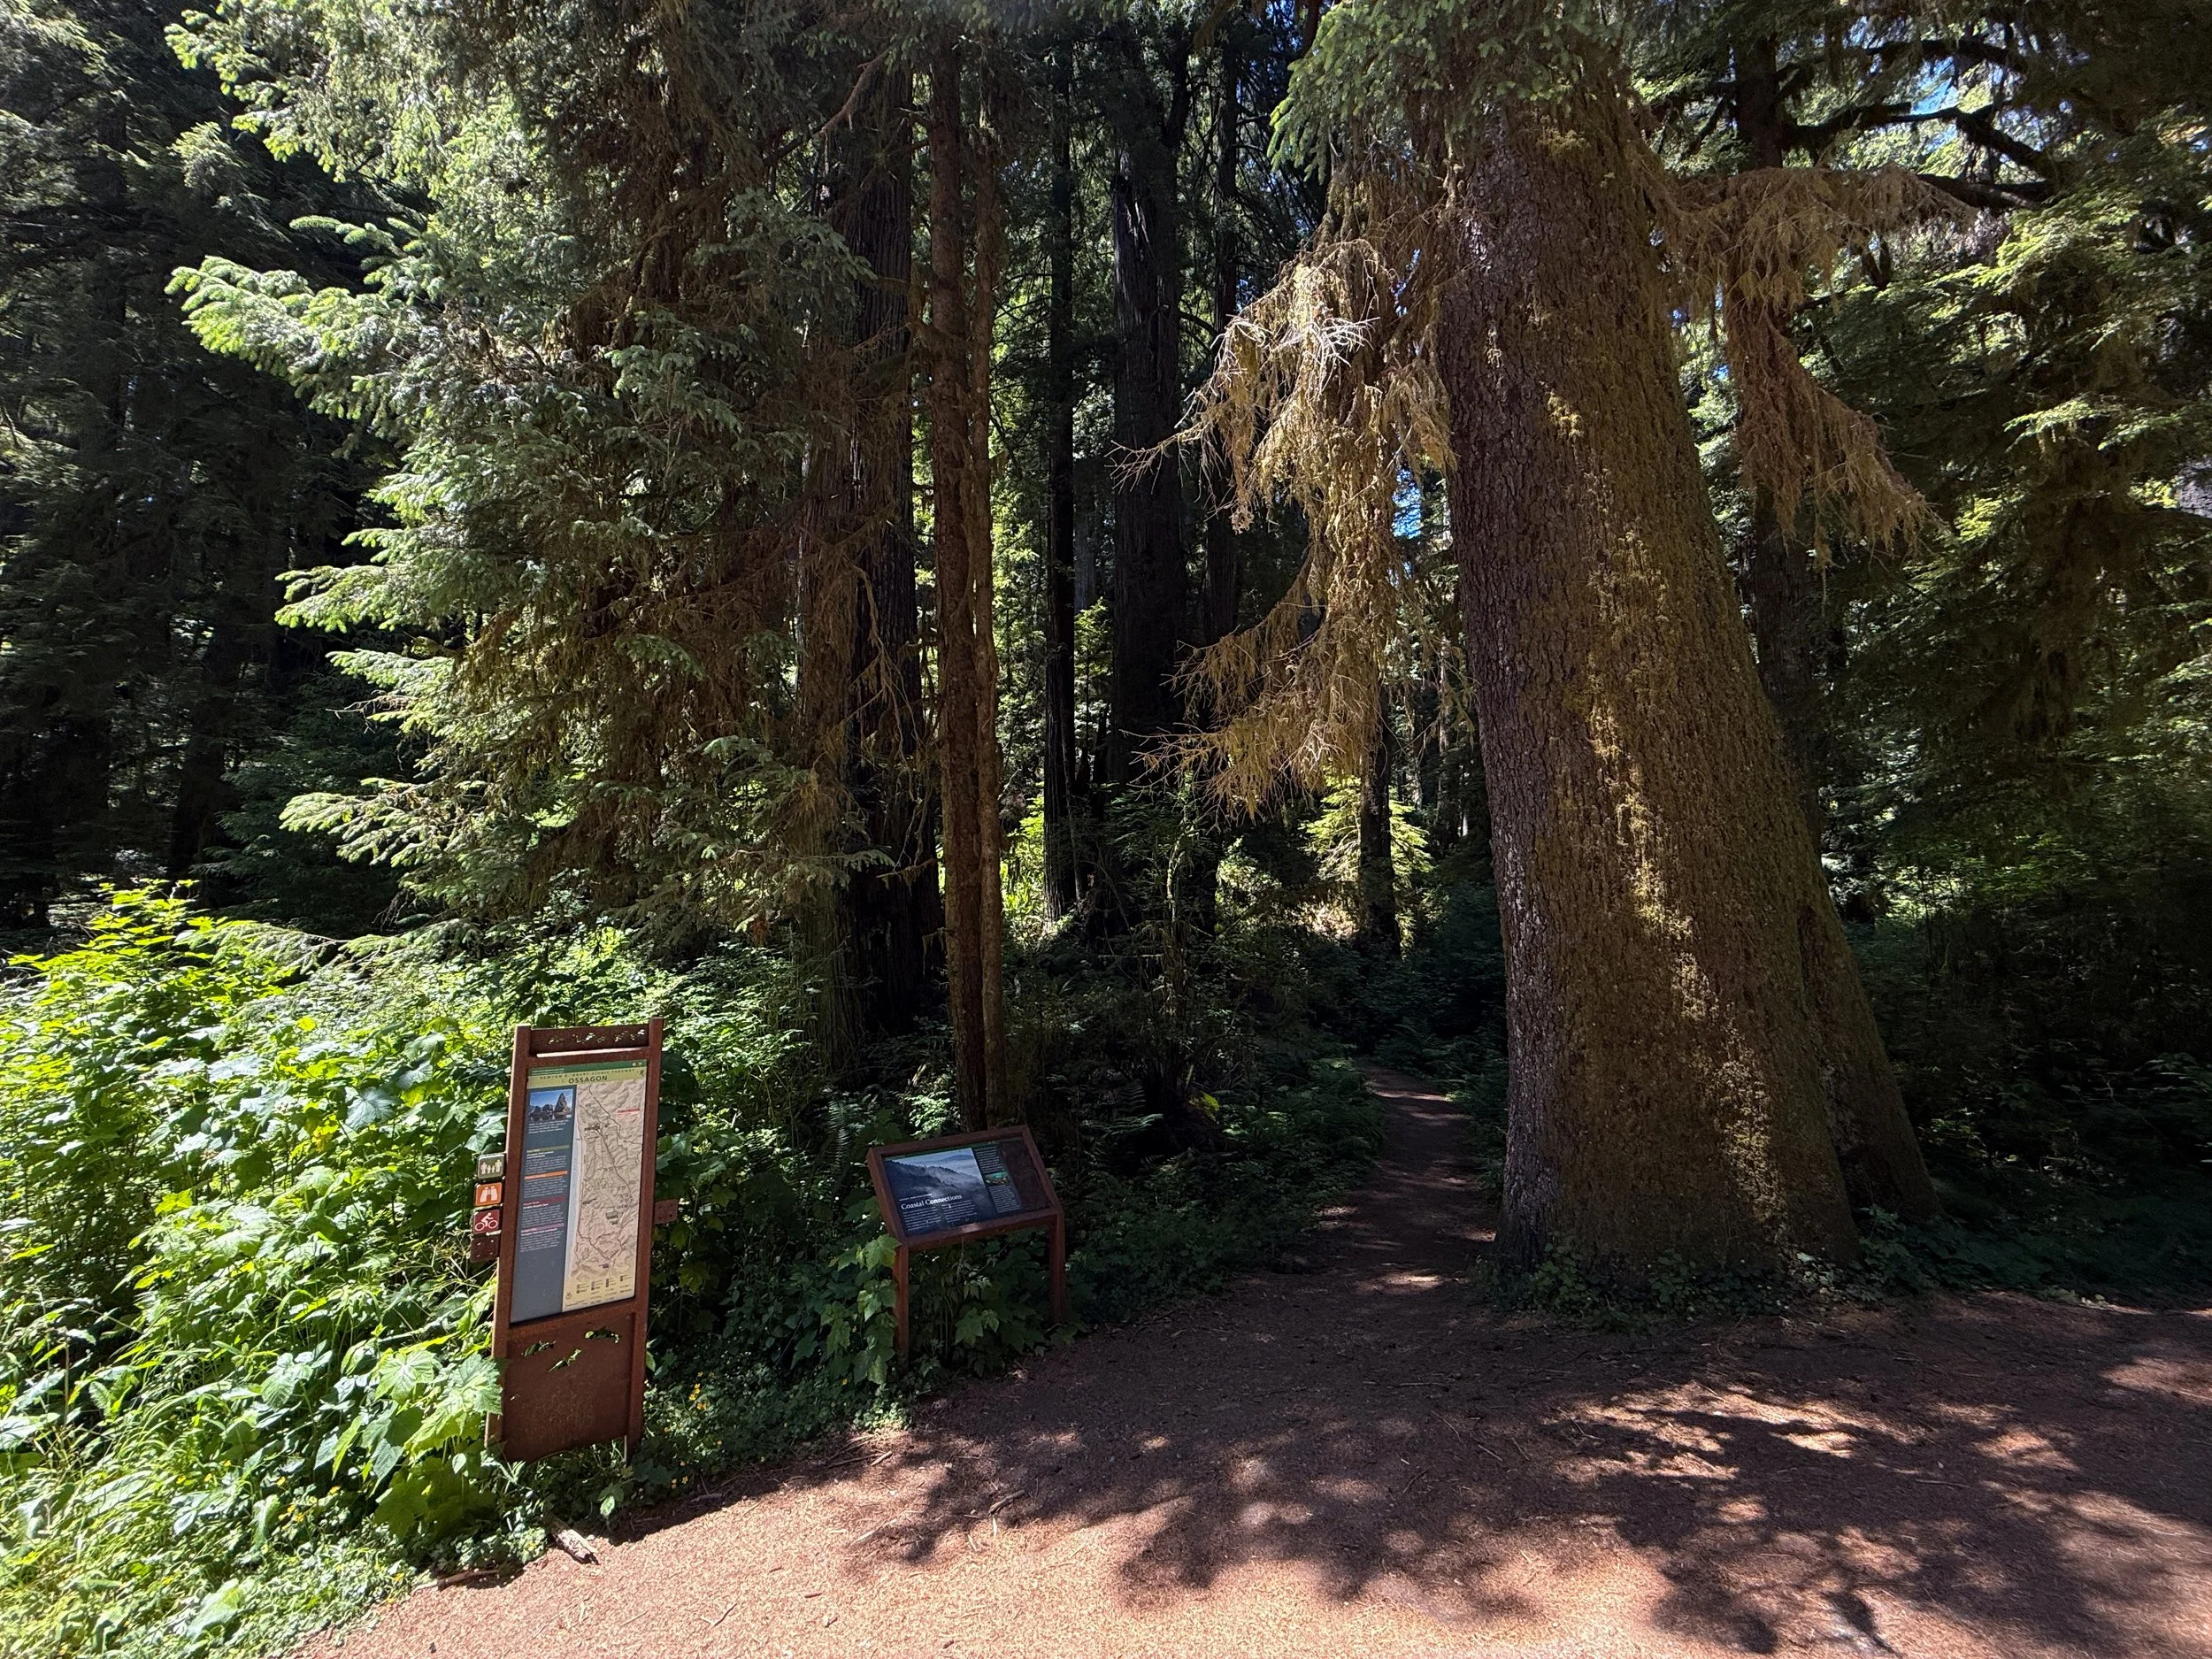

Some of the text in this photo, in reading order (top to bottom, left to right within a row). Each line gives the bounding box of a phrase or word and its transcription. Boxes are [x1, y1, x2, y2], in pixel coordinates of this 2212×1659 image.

[568, 1075, 608, 1084] OSSAGON
[901, 1200, 925, 1210] Coastal
[925, 1194, 963, 1204] Connections
